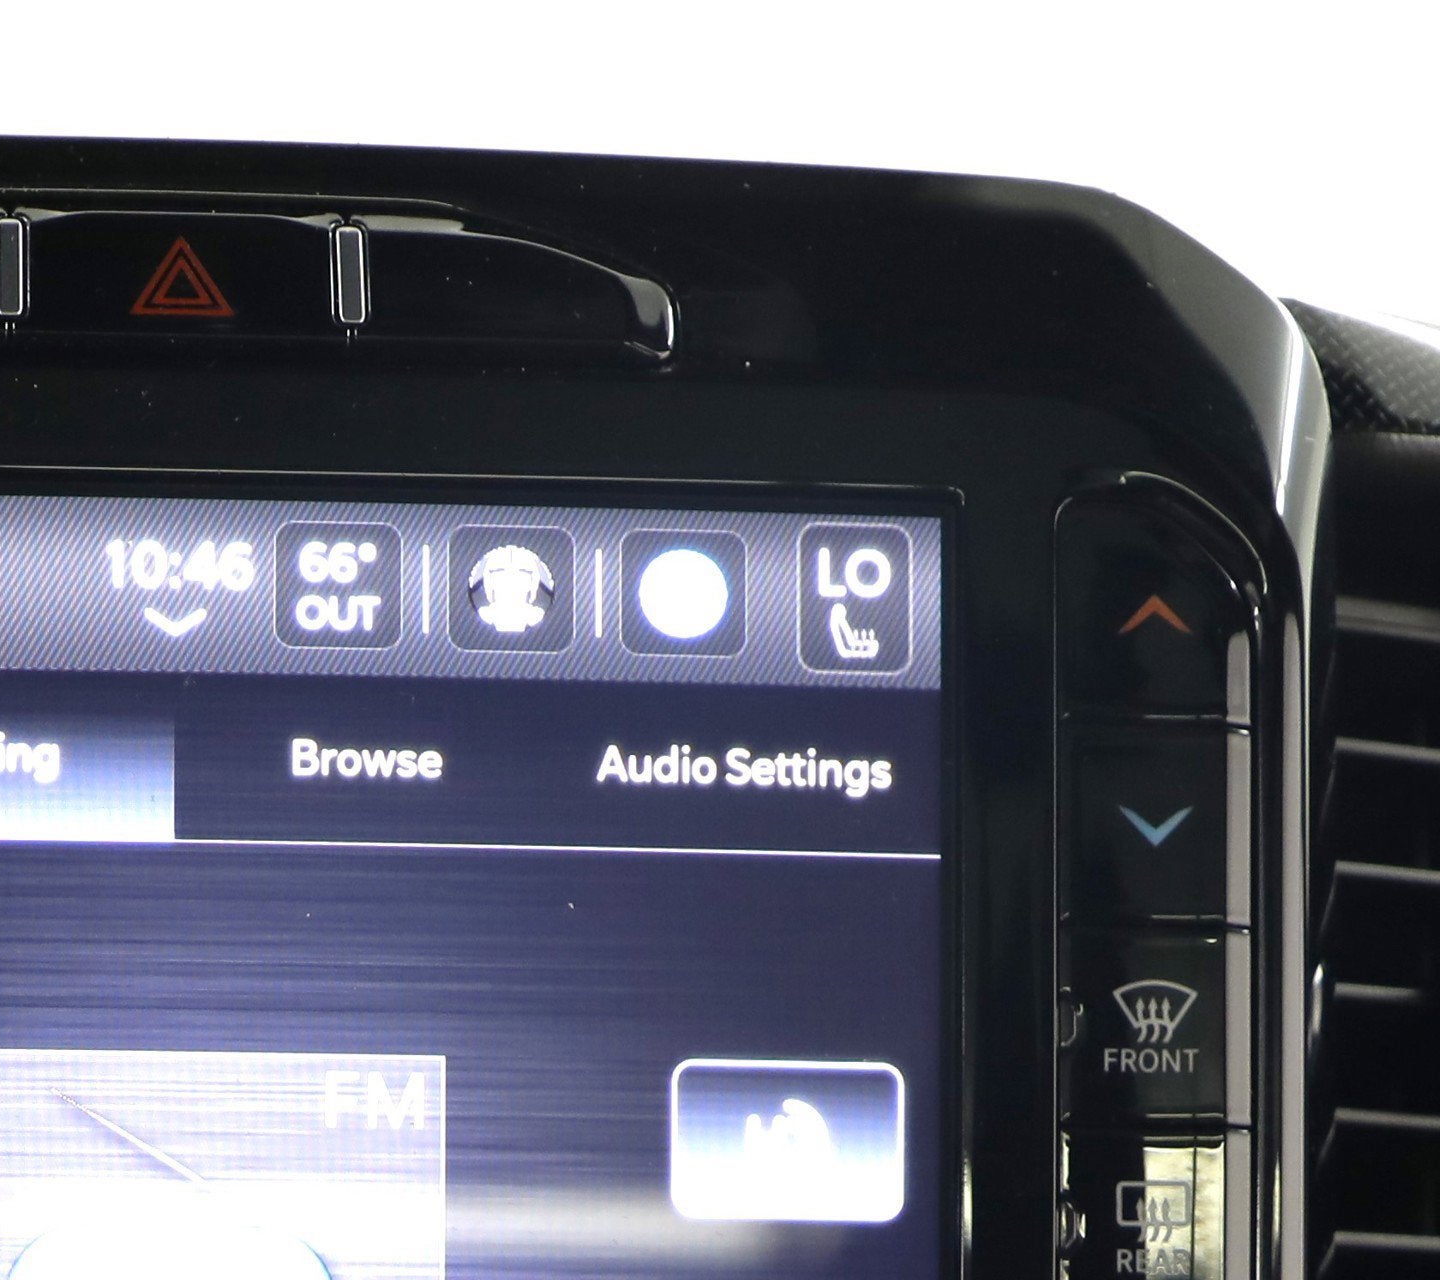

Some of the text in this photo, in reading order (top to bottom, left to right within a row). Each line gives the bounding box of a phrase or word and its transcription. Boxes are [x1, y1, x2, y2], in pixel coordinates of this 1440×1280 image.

[106, 538, 254, 592] 10:46
[817, 546, 891, 598] LO
[295, 595, 381, 632] OUT
[291, 738, 443, 779] Browse
[597, 745, 892, 798] Audio Settings
[1103, 1048, 1199, 1073] FRONT
[324, 1072, 426, 1129] FM
[1116, 1249, 1192, 1275] REAR
